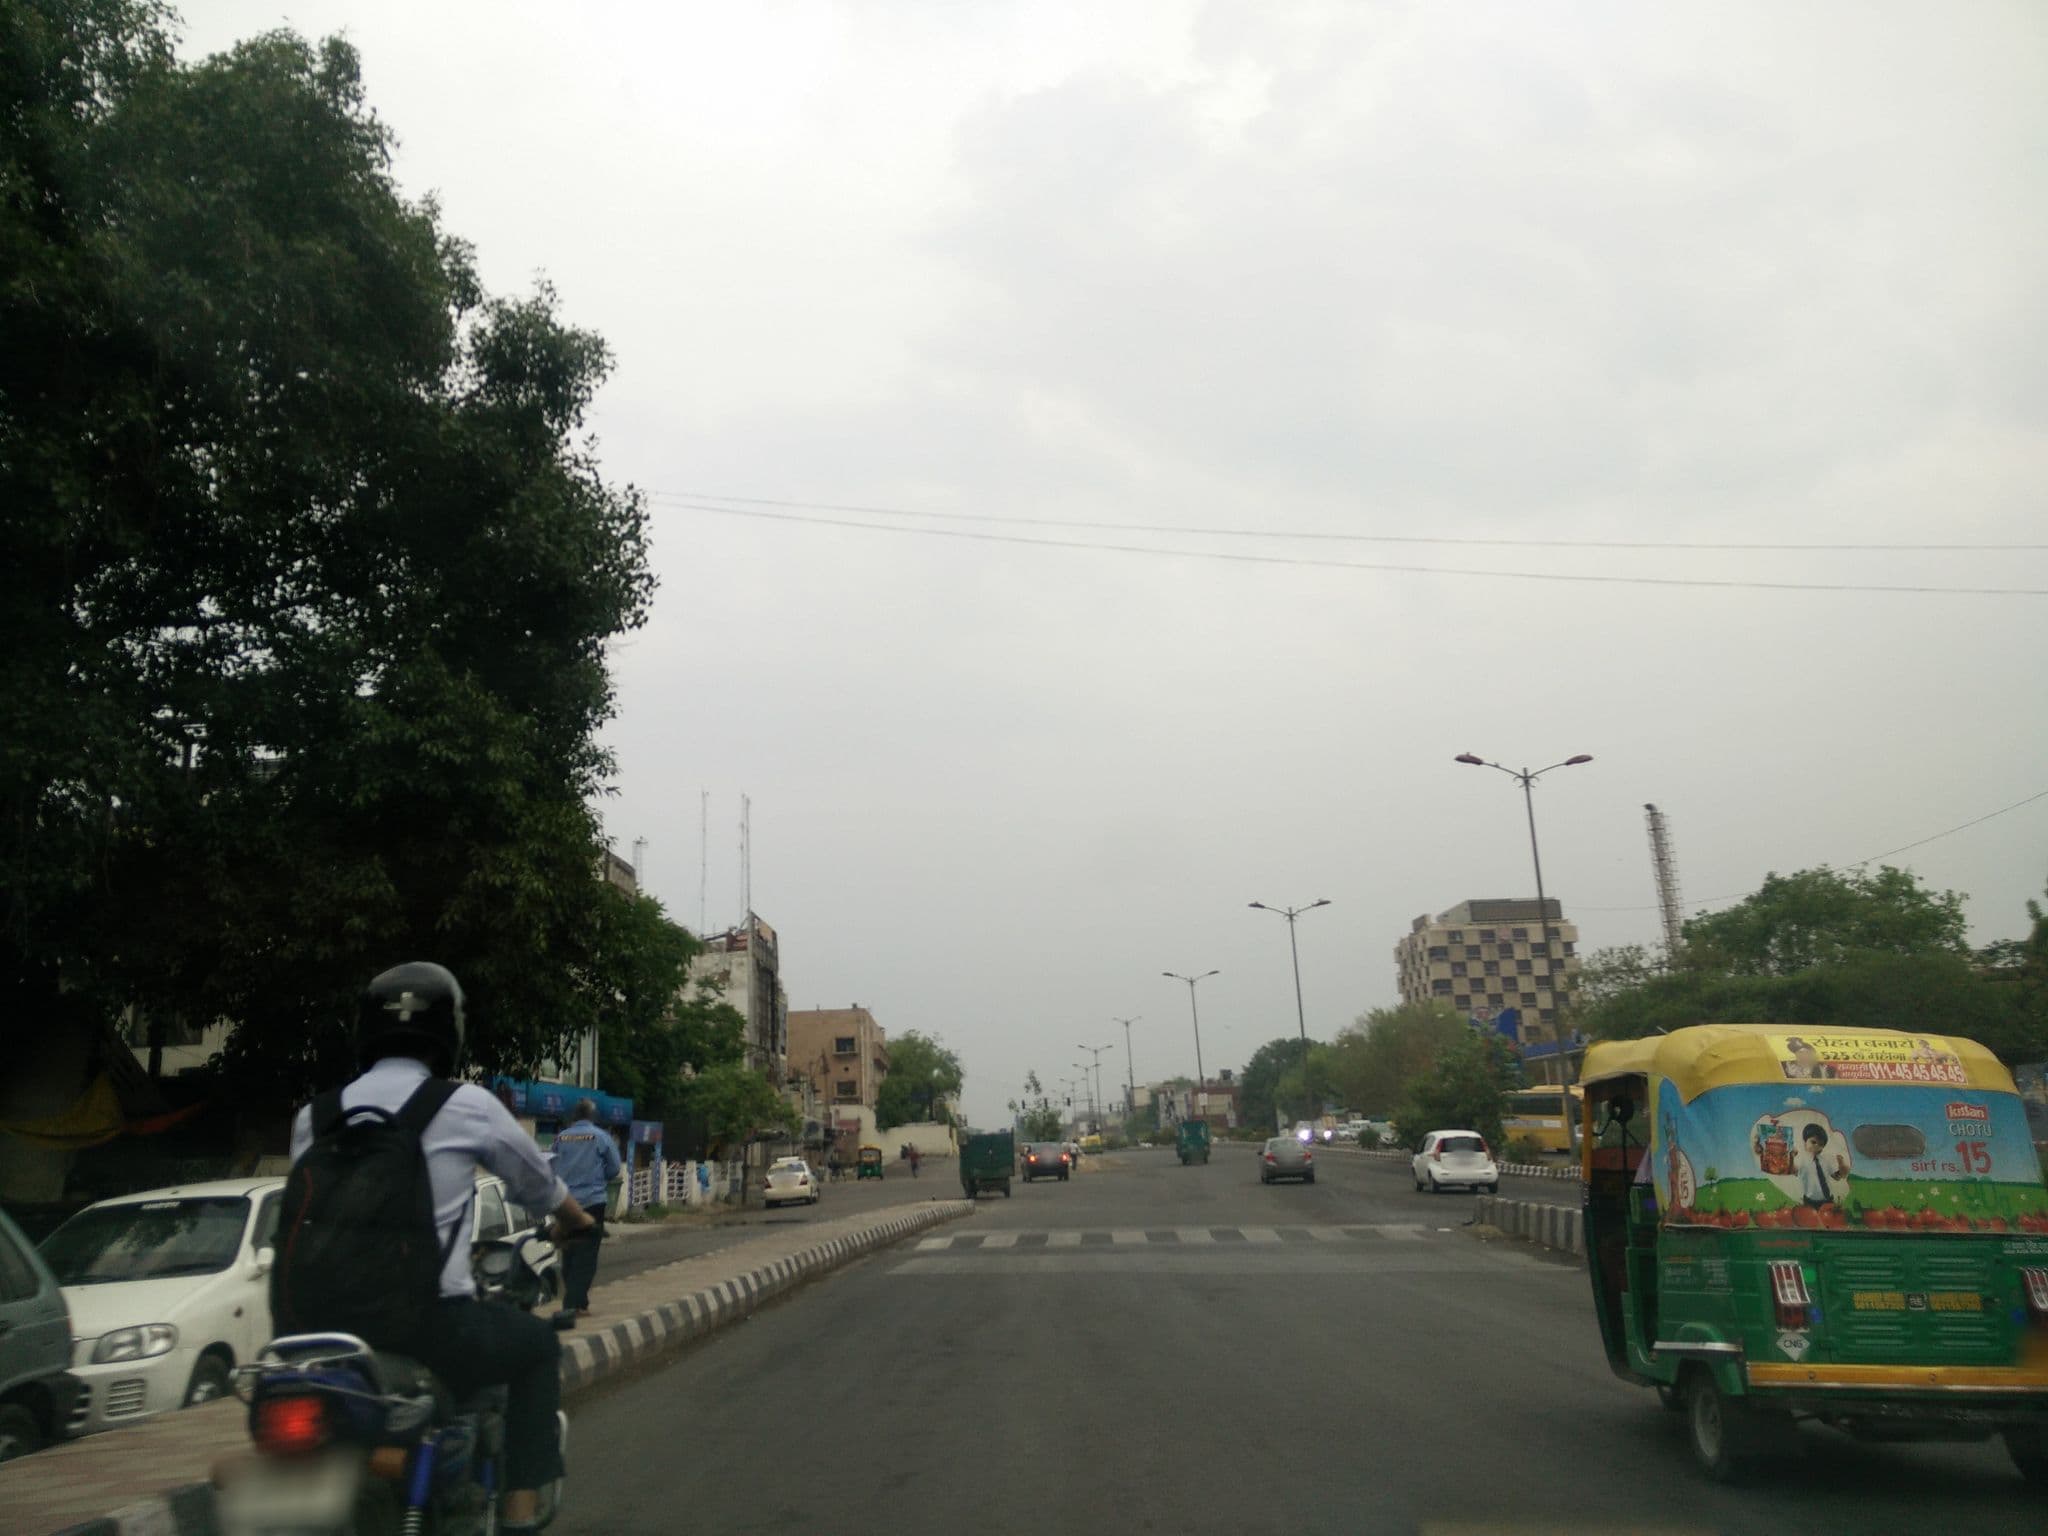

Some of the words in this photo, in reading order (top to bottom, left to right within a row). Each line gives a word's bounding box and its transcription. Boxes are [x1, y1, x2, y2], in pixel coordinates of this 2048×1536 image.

[1821, 1051, 1850, 1061] 525
[1949, 1123, 1993, 1137] CHOTU
[1911, 1159, 1937, 1172] sirf
[1941, 1160, 1960, 1173] rs.
[1955, 1140, 1993, 1174] 15
[1783, 1339, 1804, 1349] CNG
